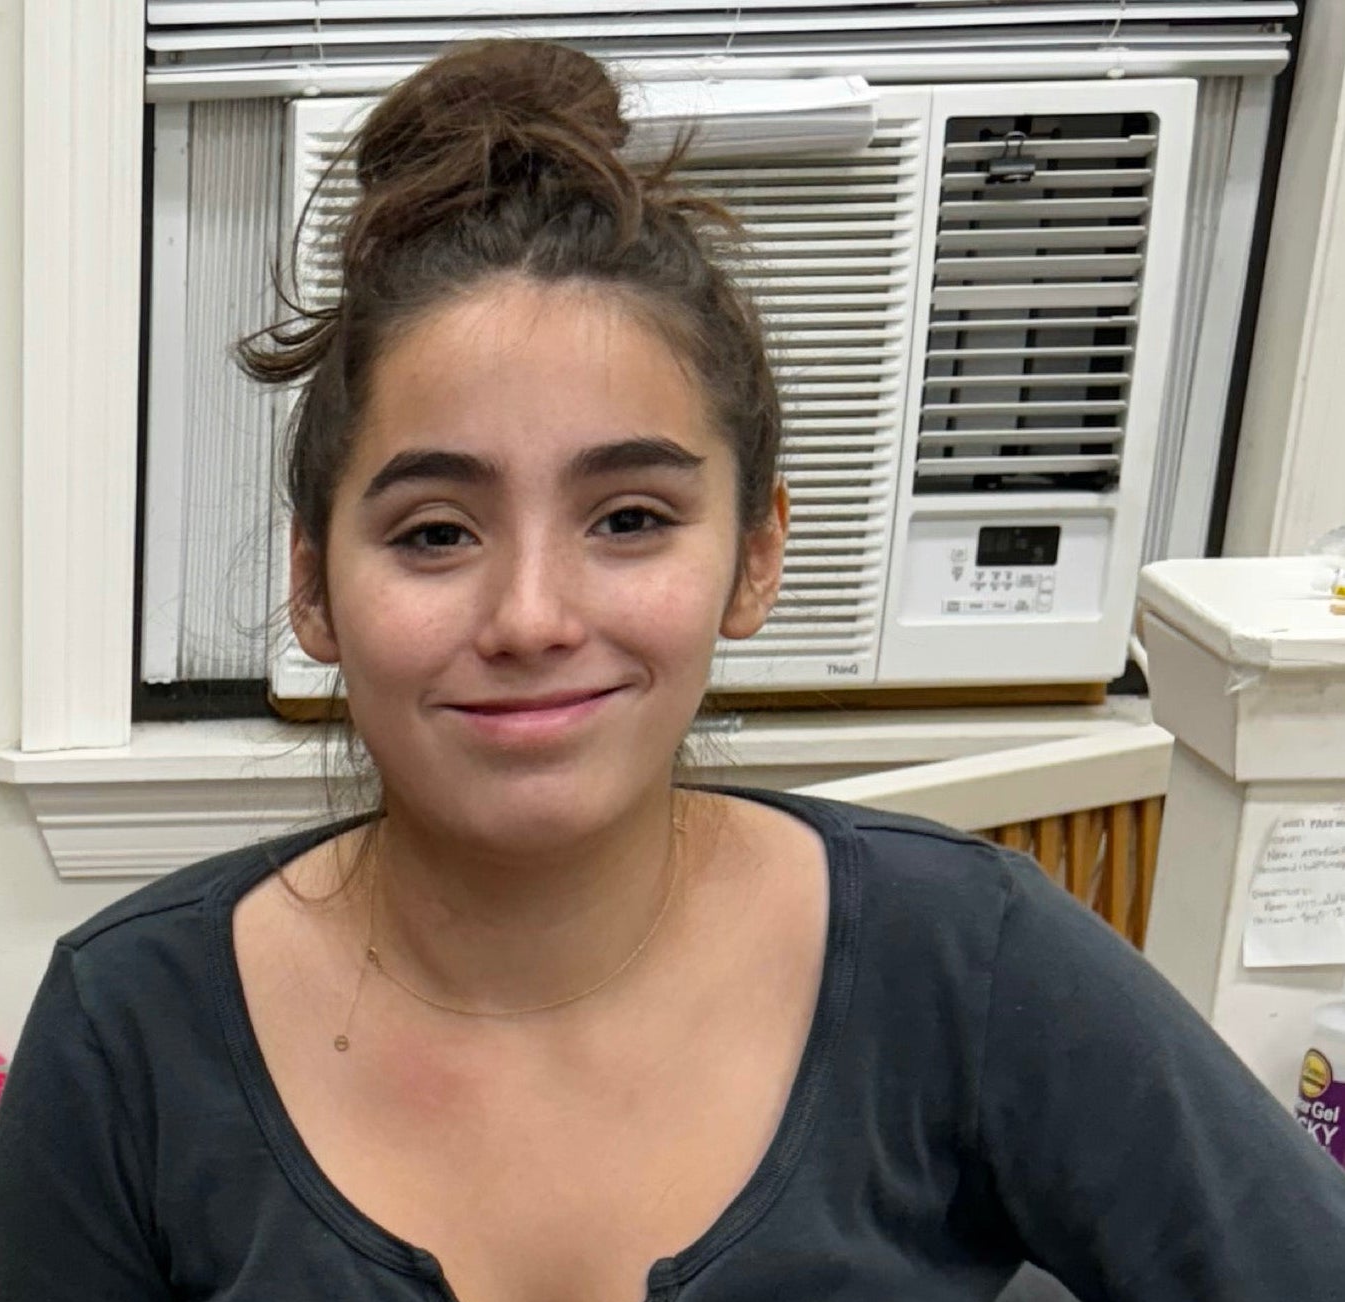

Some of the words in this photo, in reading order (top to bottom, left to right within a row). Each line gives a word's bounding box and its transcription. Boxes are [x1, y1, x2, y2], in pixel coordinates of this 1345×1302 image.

[827, 665, 858, 675] ThinQ
[1312, 1101, 1341, 1123] Gel
[1298, 1115, 1340, 1145] CKY
